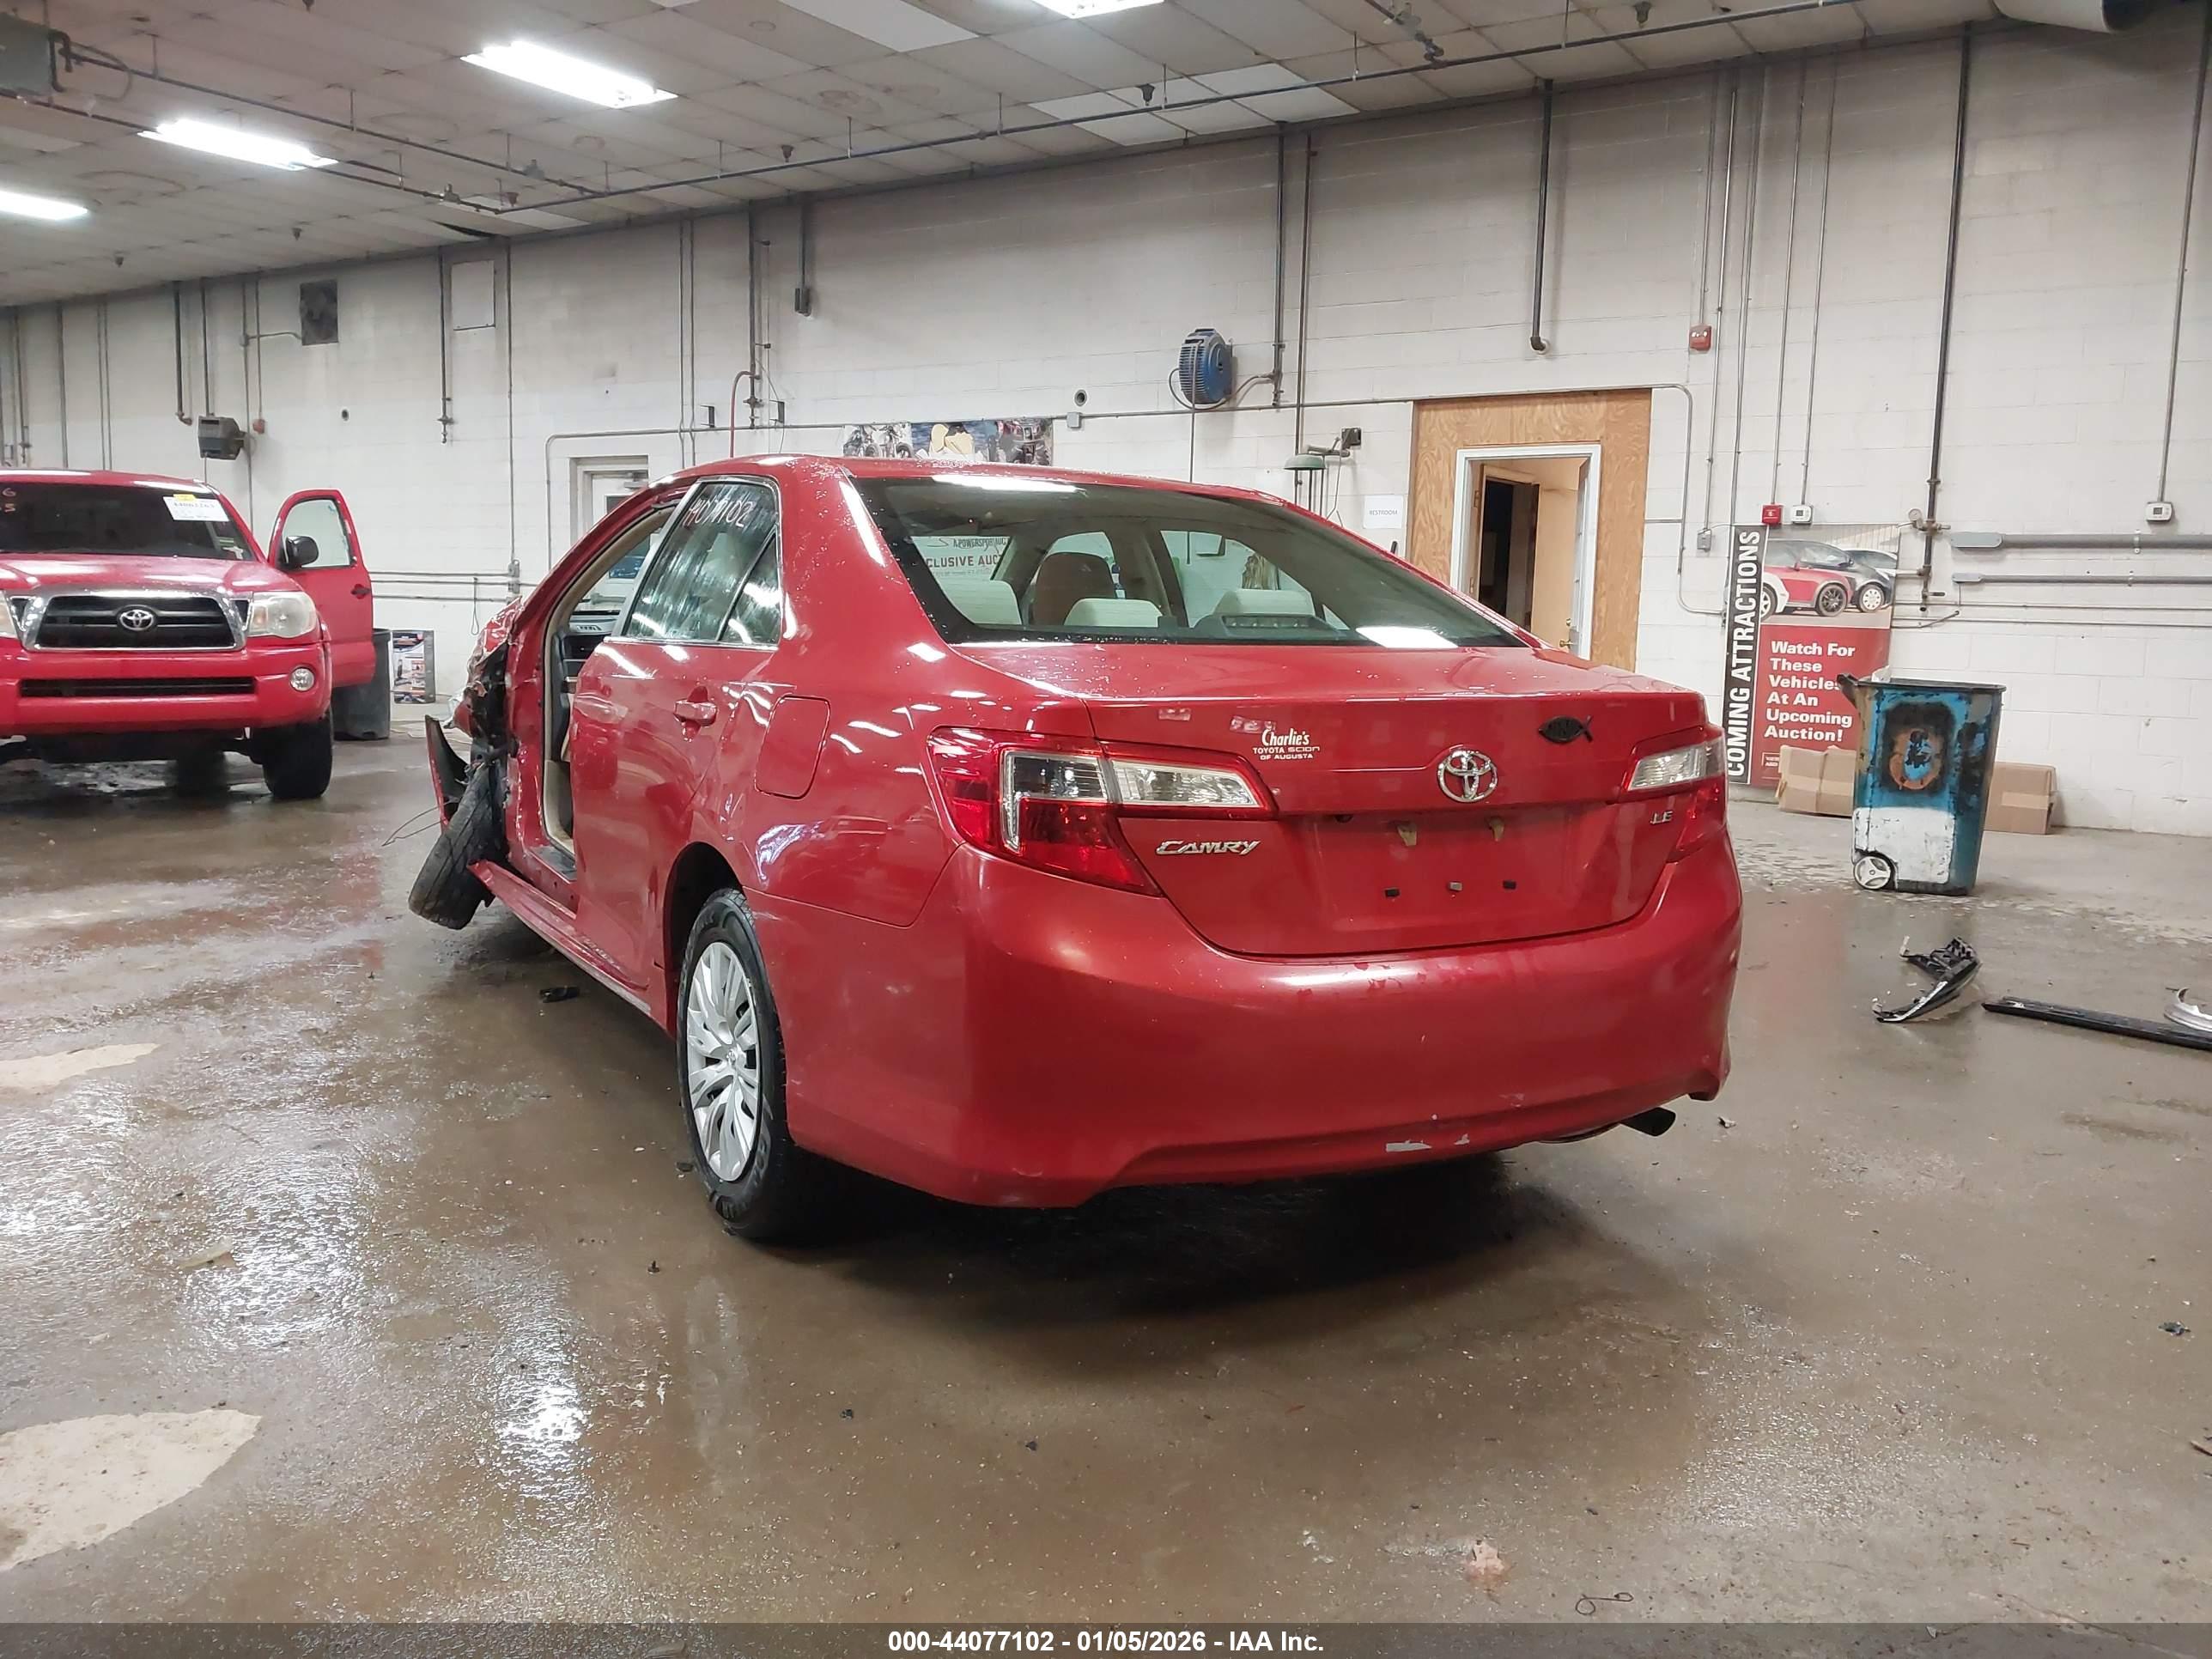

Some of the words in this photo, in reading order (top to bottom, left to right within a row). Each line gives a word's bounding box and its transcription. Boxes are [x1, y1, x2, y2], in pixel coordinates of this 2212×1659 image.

[1730, 532, 1760, 682] ATTRACTIONS
[1771, 641, 1822, 655] Watch
[1827, 643, 1856, 656] For
[1770, 658, 1822, 672] These
[1767, 691, 1789, 704] At
[1793, 693, 1818, 707] An
[1766, 708, 1852, 728] Upcoming
[1261, 728, 1310, 746] Charlie's
[1727, 688, 1751, 776] COMING
[1764, 726, 1844, 742] Auction!
[1650, 811, 1673, 824] LE
[1156, 841, 1261, 854] CAMRY
